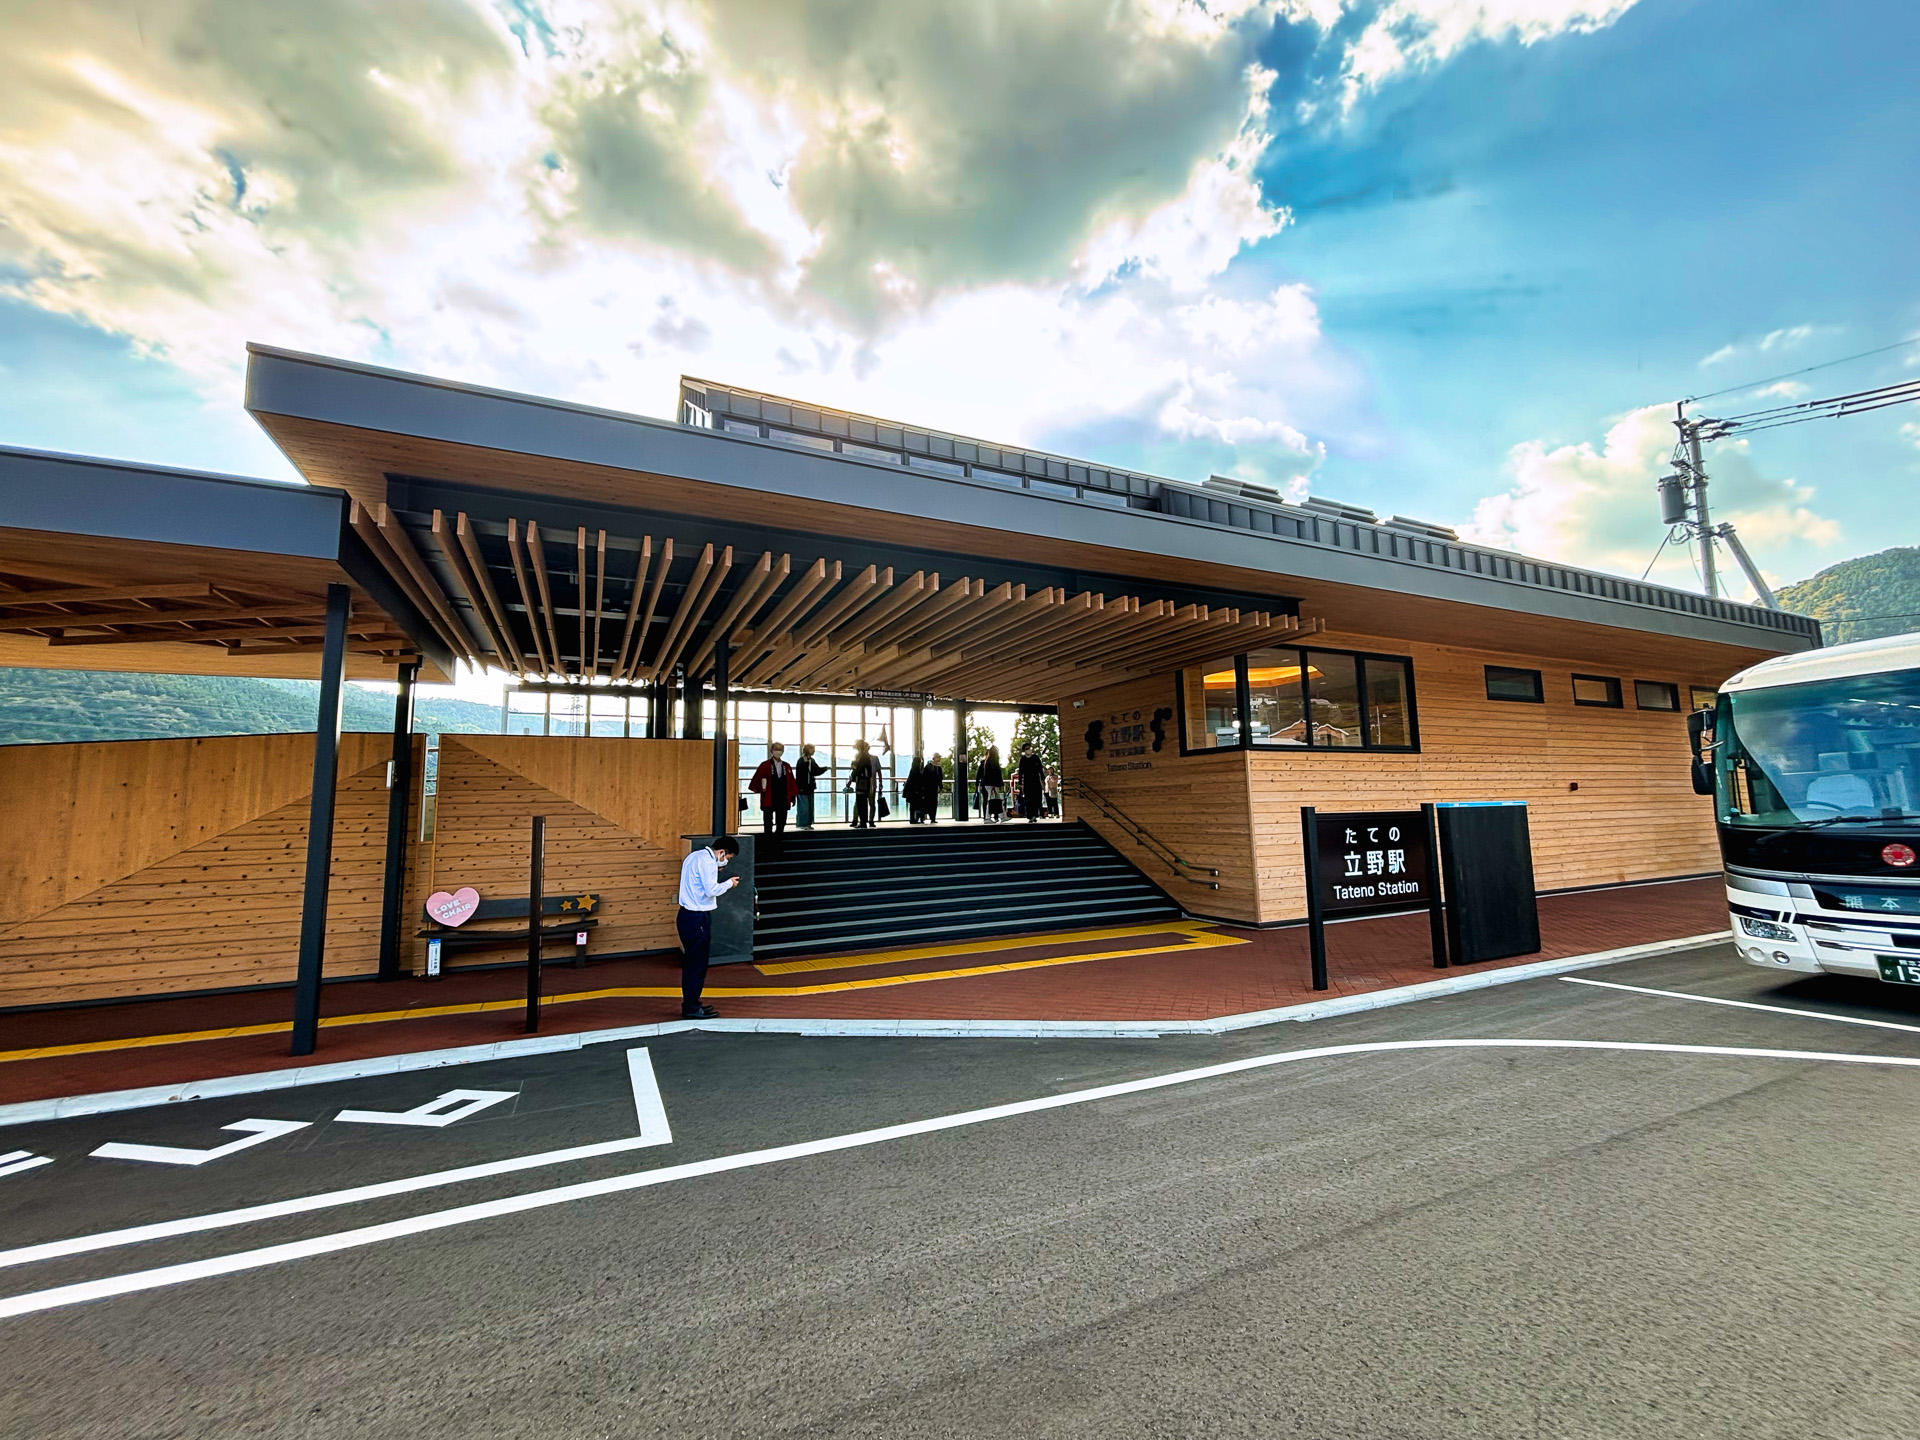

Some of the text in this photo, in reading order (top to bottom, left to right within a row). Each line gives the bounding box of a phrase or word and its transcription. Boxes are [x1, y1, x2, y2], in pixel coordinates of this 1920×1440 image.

[1345, 826, 1401, 844] たての
[1343, 849, 1406, 876] 立野駅
[1333, 880, 1419, 900] Tateno Station
[434, 899, 460, 914] LOVE
[442, 903, 471, 918] CHAIR
[1844, 894, 1920, 910] 熊本
